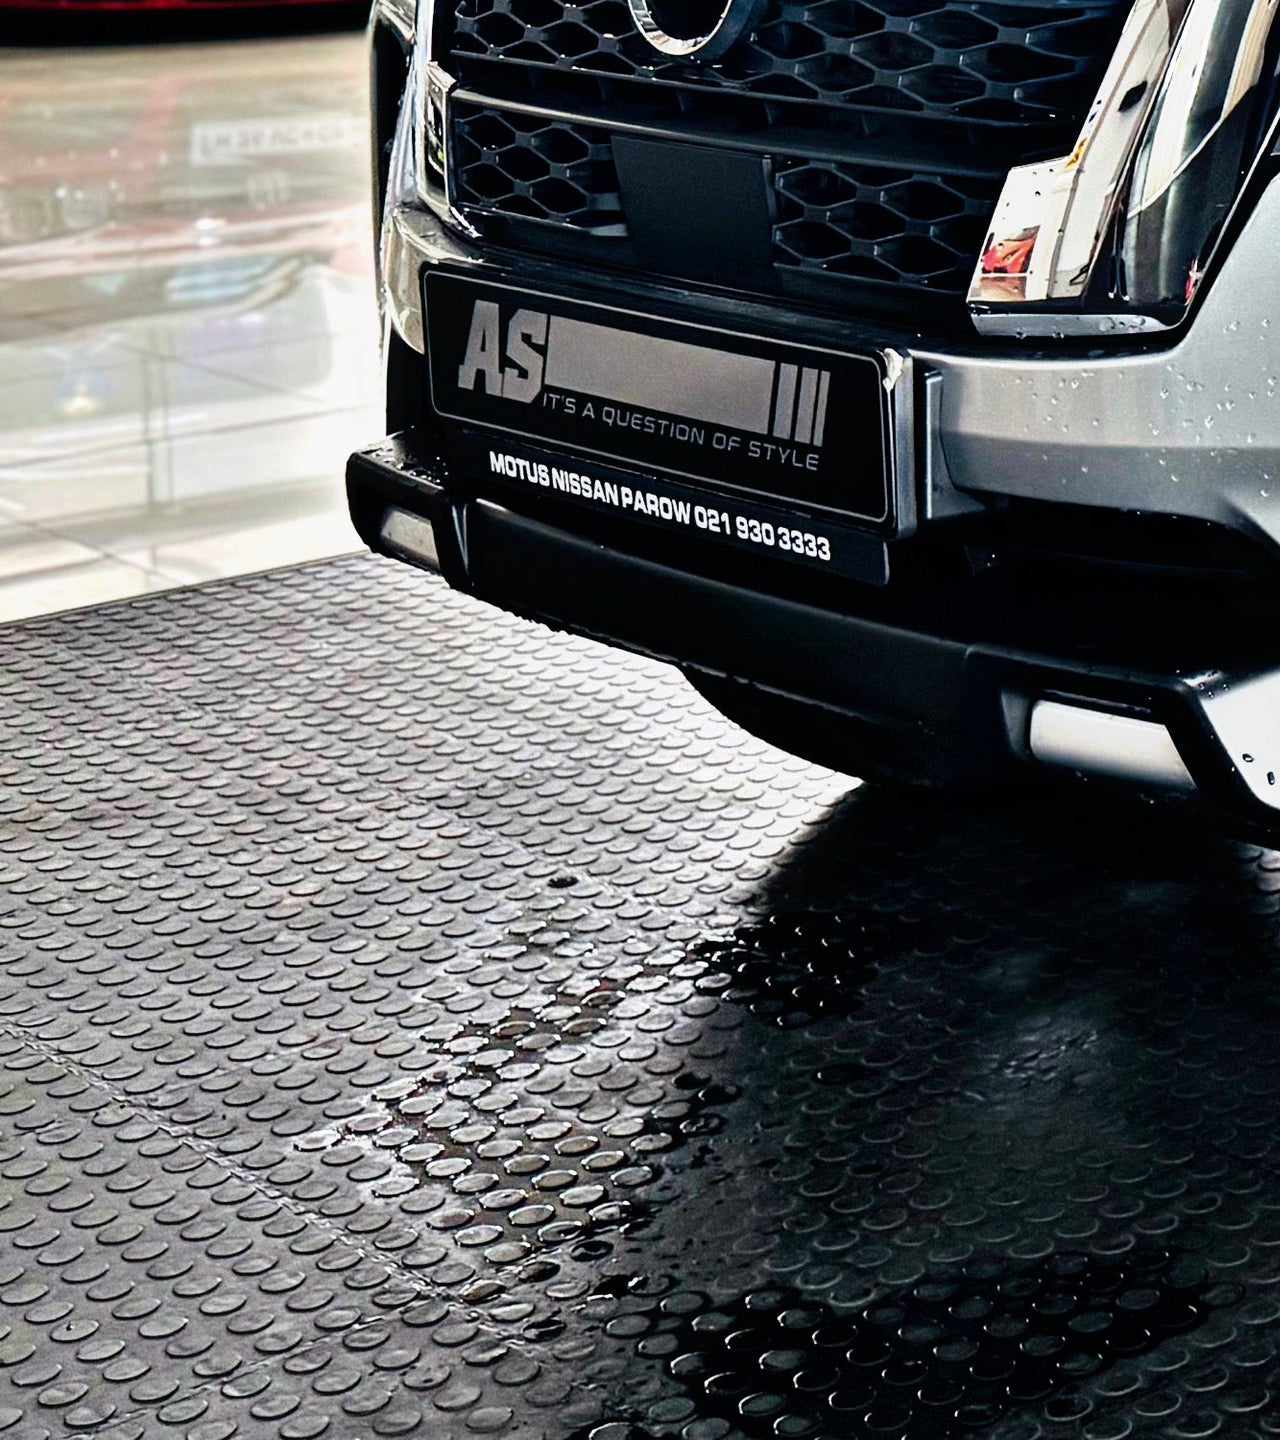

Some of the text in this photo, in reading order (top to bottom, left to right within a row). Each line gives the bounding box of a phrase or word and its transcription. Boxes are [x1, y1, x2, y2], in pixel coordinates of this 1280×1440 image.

[458, 299, 548, 404] AS
[543, 393, 820, 471] IT'S A QUESTION OF STYLE
[489, 450, 832, 561] MOTUS NISSAN PAROW 021 930 3333
